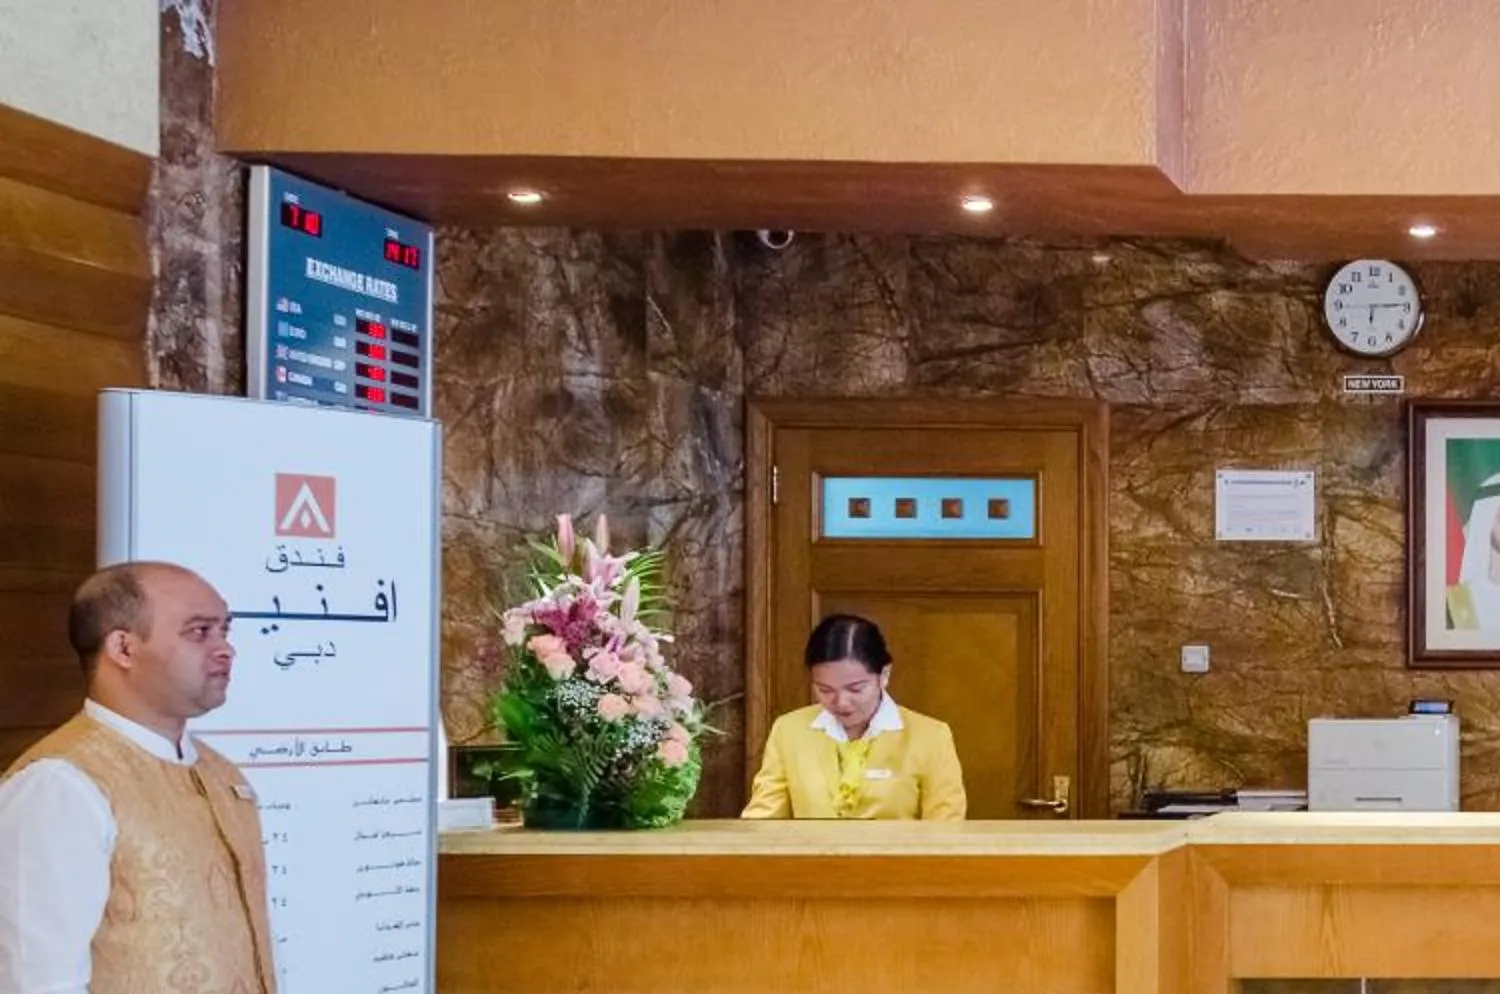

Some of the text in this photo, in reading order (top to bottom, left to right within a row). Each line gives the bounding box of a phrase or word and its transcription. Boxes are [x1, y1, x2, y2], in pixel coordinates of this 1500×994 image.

[305, 256, 399, 304] EXCHANGE RATES
[1348, 379, 1399, 389] NEW YORK
[265, 545, 345, 573] فندق
[229, 578, 397, 635] افني
[273, 640, 336, 670] دبي
